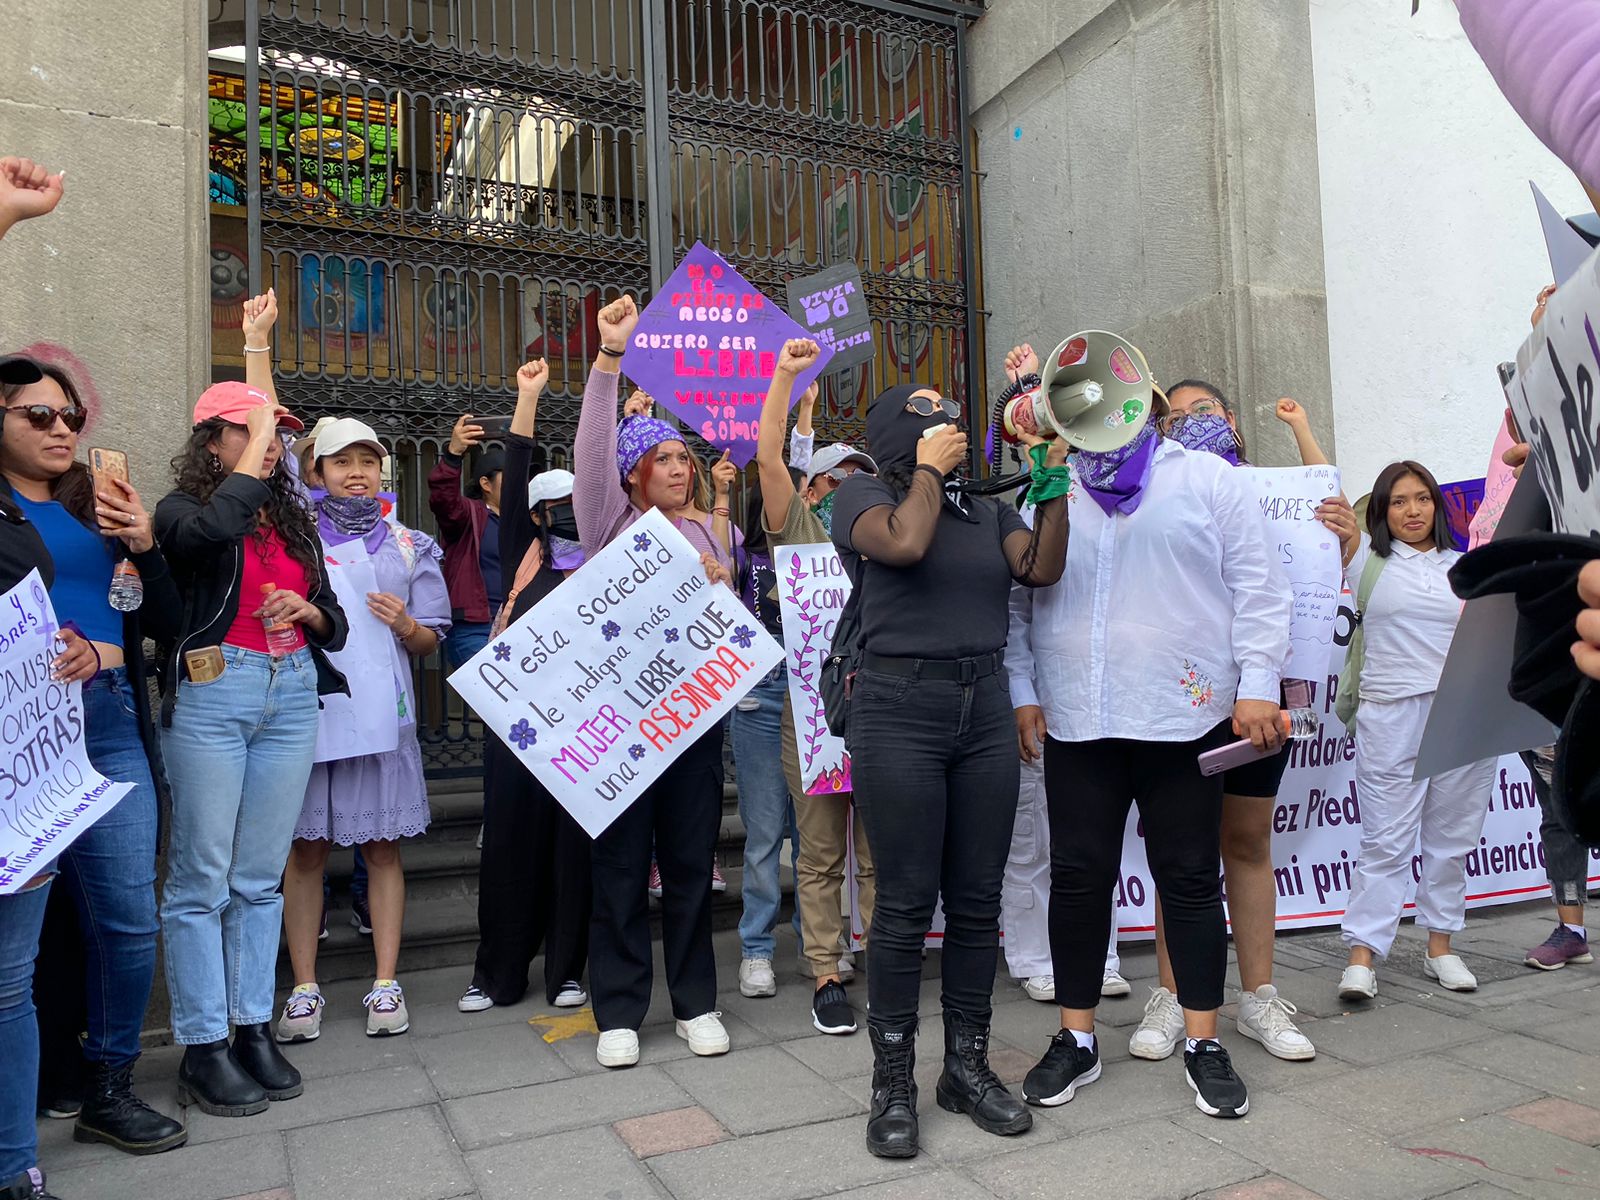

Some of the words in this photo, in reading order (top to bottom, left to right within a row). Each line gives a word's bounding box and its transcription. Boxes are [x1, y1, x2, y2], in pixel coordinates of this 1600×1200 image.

[799, 281, 856, 309] VIVIR
[679, 306, 748, 323] ACOSO
[634, 333, 708, 349] QUIERO
[719, 335, 757, 350] SER
[674, 349, 776, 379] LIBRE
[705, 405, 736, 419] YA
[478, 662, 518, 702] A
[519, 626, 570, 674] esta
[577, 529, 674, 625] sociedad
[528, 701, 565, 728] le
[567, 644, 631, 703] indigna
[633, 602, 671, 641] más
[672, 573, 705, 604] una
[550, 703, 632, 784] MUJER
[623, 649, 685, 709] LIBRE
[686, 601, 735, 651] QUE
[595, 759, 639, 802] una
[639, 645, 756, 752] ASESINADA.
